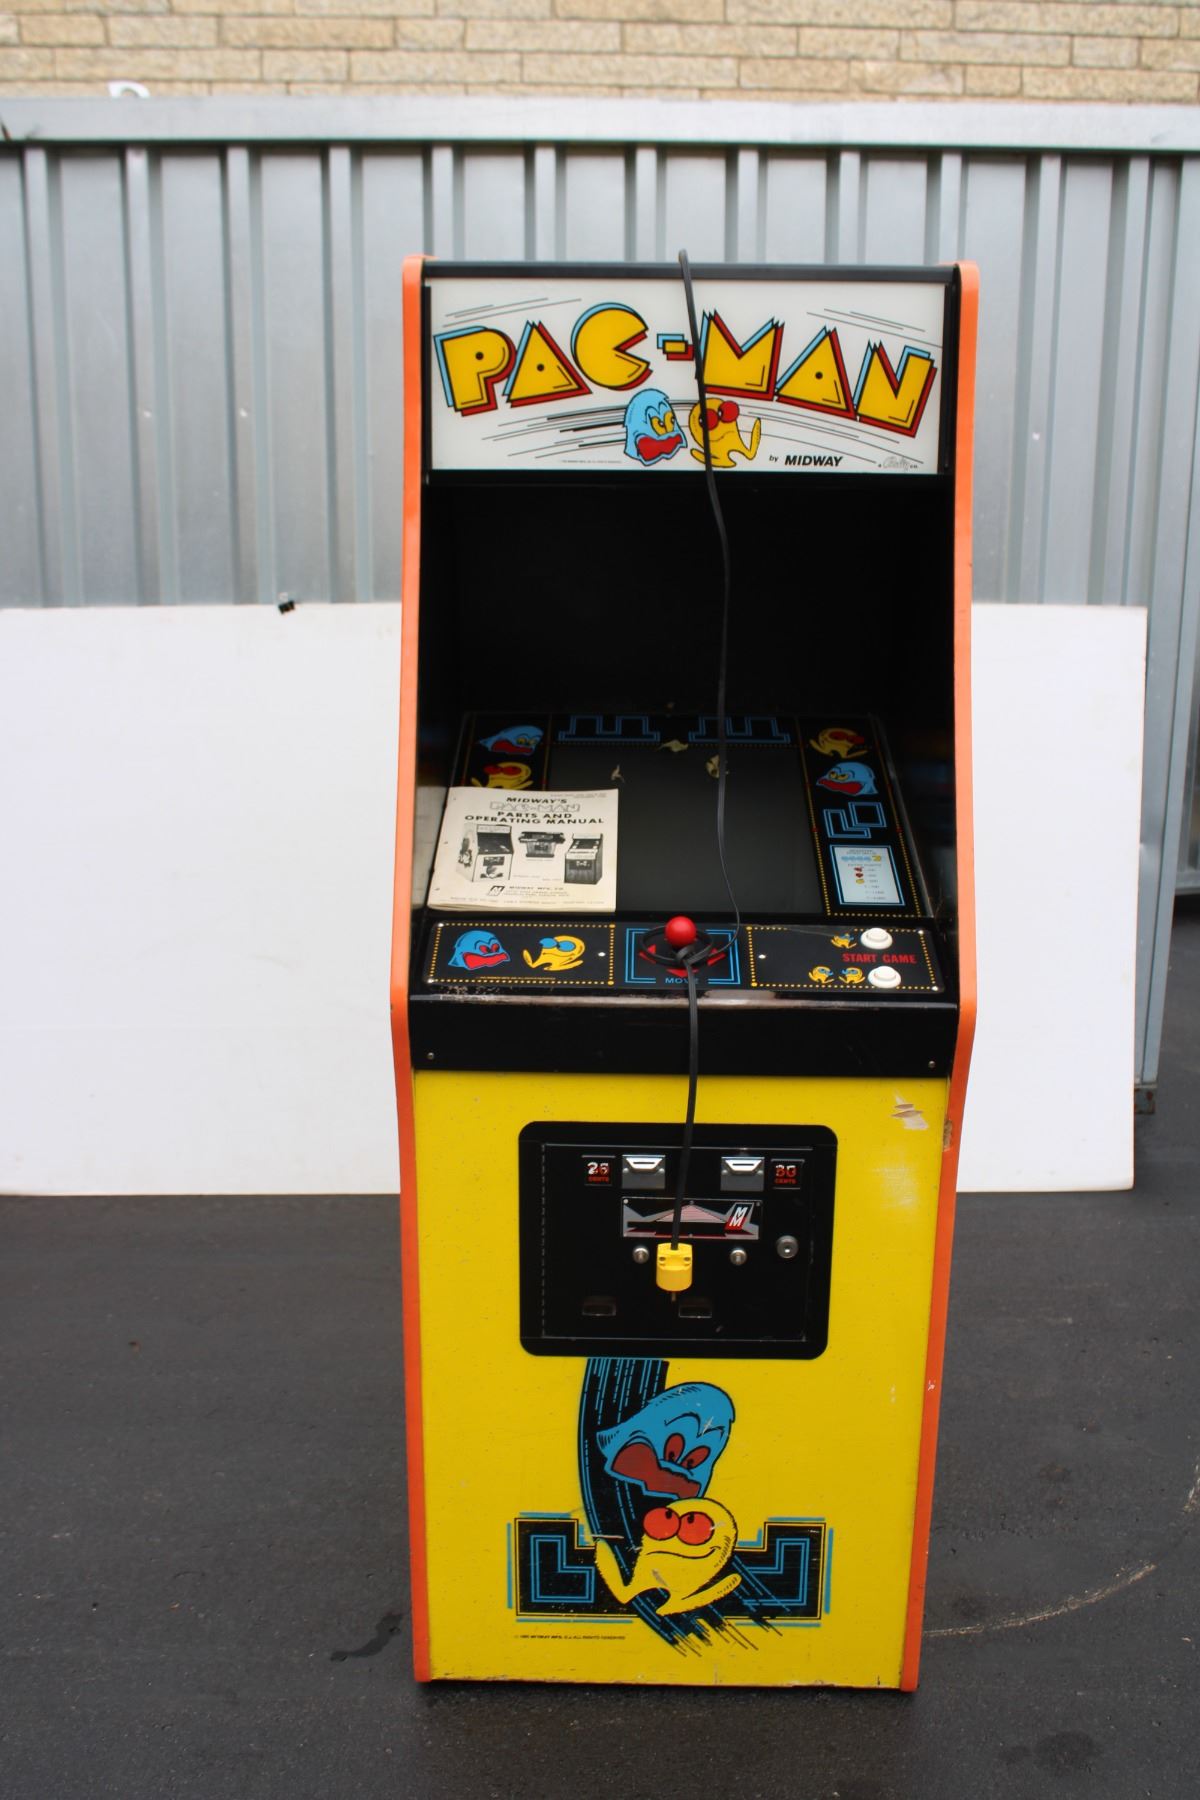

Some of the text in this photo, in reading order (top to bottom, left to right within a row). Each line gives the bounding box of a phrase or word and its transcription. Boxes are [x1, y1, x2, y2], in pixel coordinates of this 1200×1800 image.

[433, 302, 938, 437] PAC-MAN
[769, 454, 843, 466] by MIDWAY
[464, 815, 540, 824] OPERATING
[842, 952, 917, 964] START GAME
